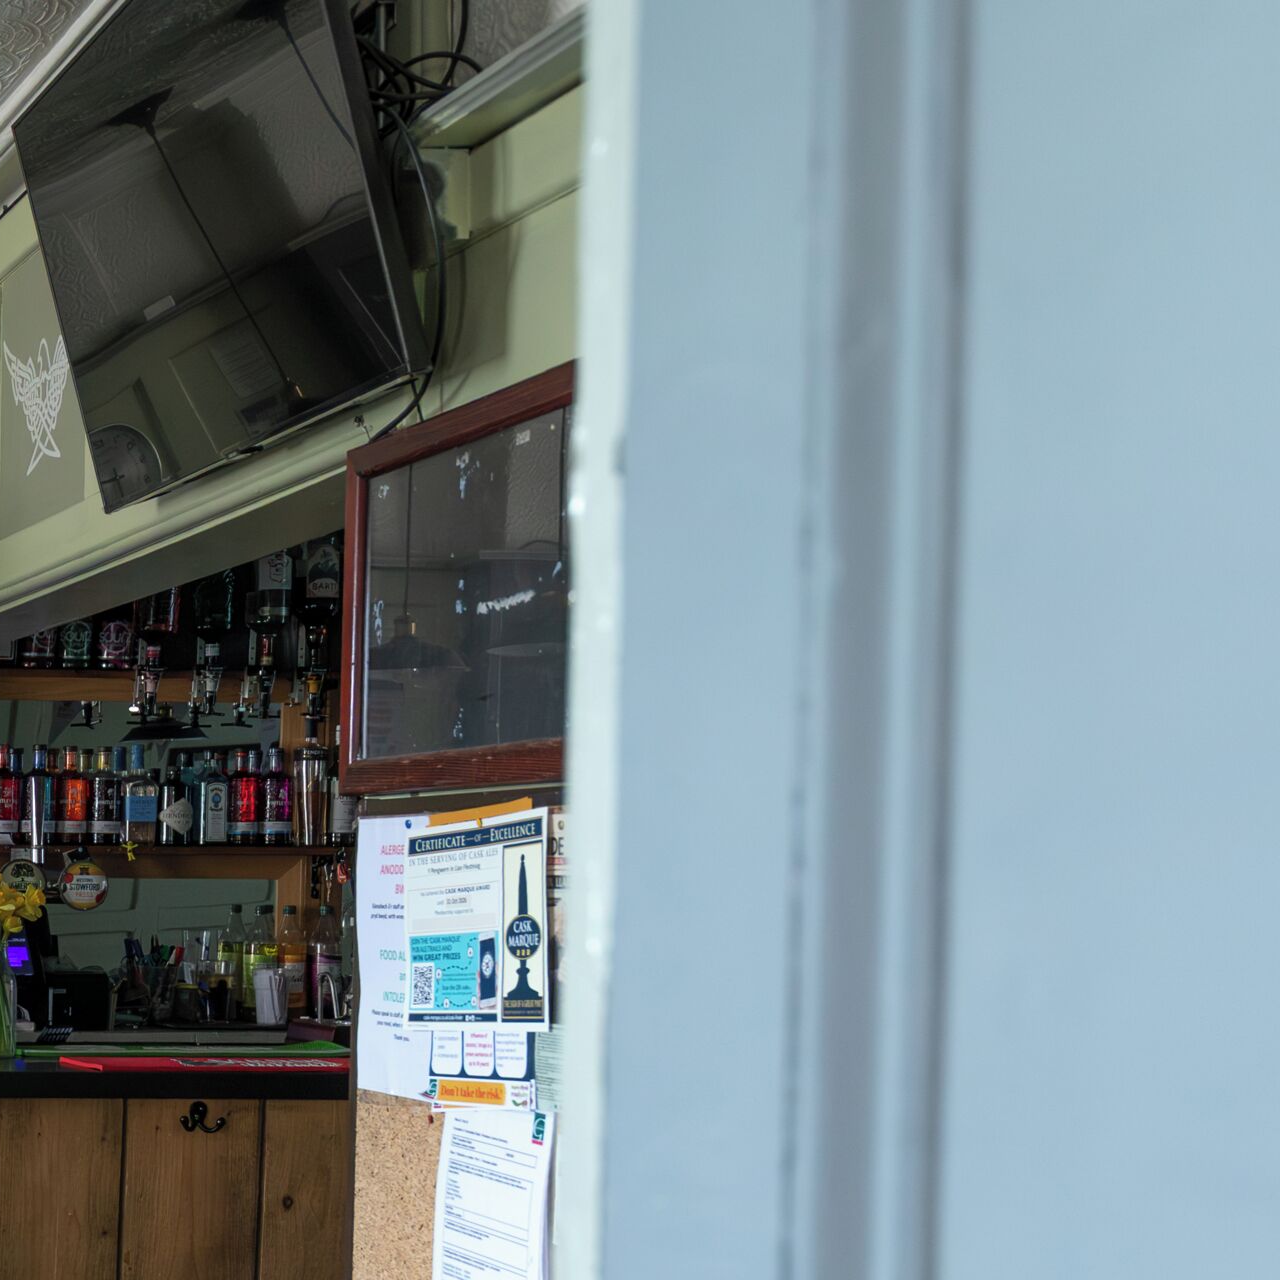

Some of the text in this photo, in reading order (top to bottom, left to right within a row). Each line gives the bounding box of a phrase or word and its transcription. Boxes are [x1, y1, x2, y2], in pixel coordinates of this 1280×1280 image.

[415, 835, 466, 852] CERTIFICATE
[489, 823, 536, 841] EXCELLENCE
[417, 857, 429, 866] THE
[430, 853, 458, 865] SERVING
[458, 852, 468, 860] OF
[468, 849, 484, 859] CASK
[69, 883, 101, 892] STOWFORD
[513, 920, 533, 933] CASK
[508, 933, 540, 948] MARQUE
[379, 949, 397, 961] FOOD
[440, 1085, 460, 1097] Don't
[460, 1087, 475, 1097] take
[475, 1087, 485, 1098] the
